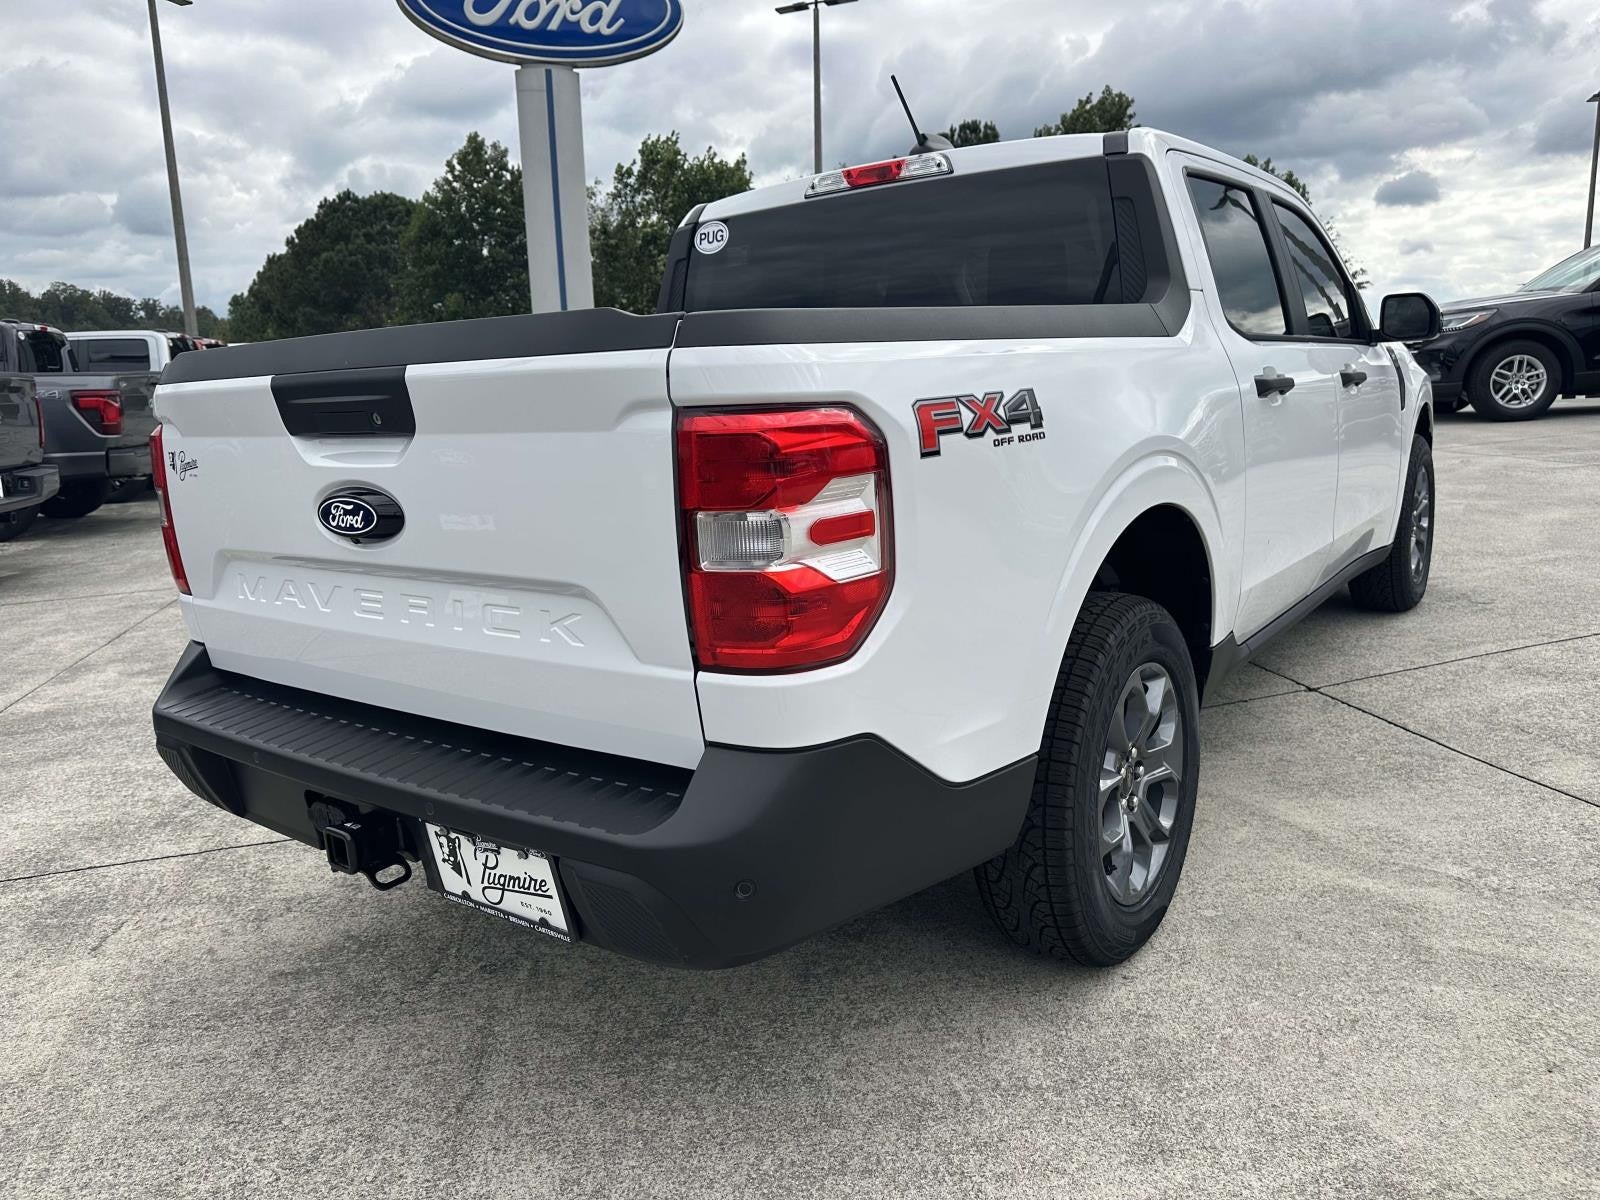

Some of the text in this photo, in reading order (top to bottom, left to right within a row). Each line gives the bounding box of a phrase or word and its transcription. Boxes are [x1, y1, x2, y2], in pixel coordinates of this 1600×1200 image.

[699, 229, 724, 246] PUG
[912, 387, 1044, 459] FX4
[993, 431, 1046, 447] OFF ROAD
[329, 502, 364, 529] Ford
[237, 573, 585, 647] MAVERICK
[474, 847, 553, 905] Pugmire
[534, 925, 571, 942] CARTERSVILLE
